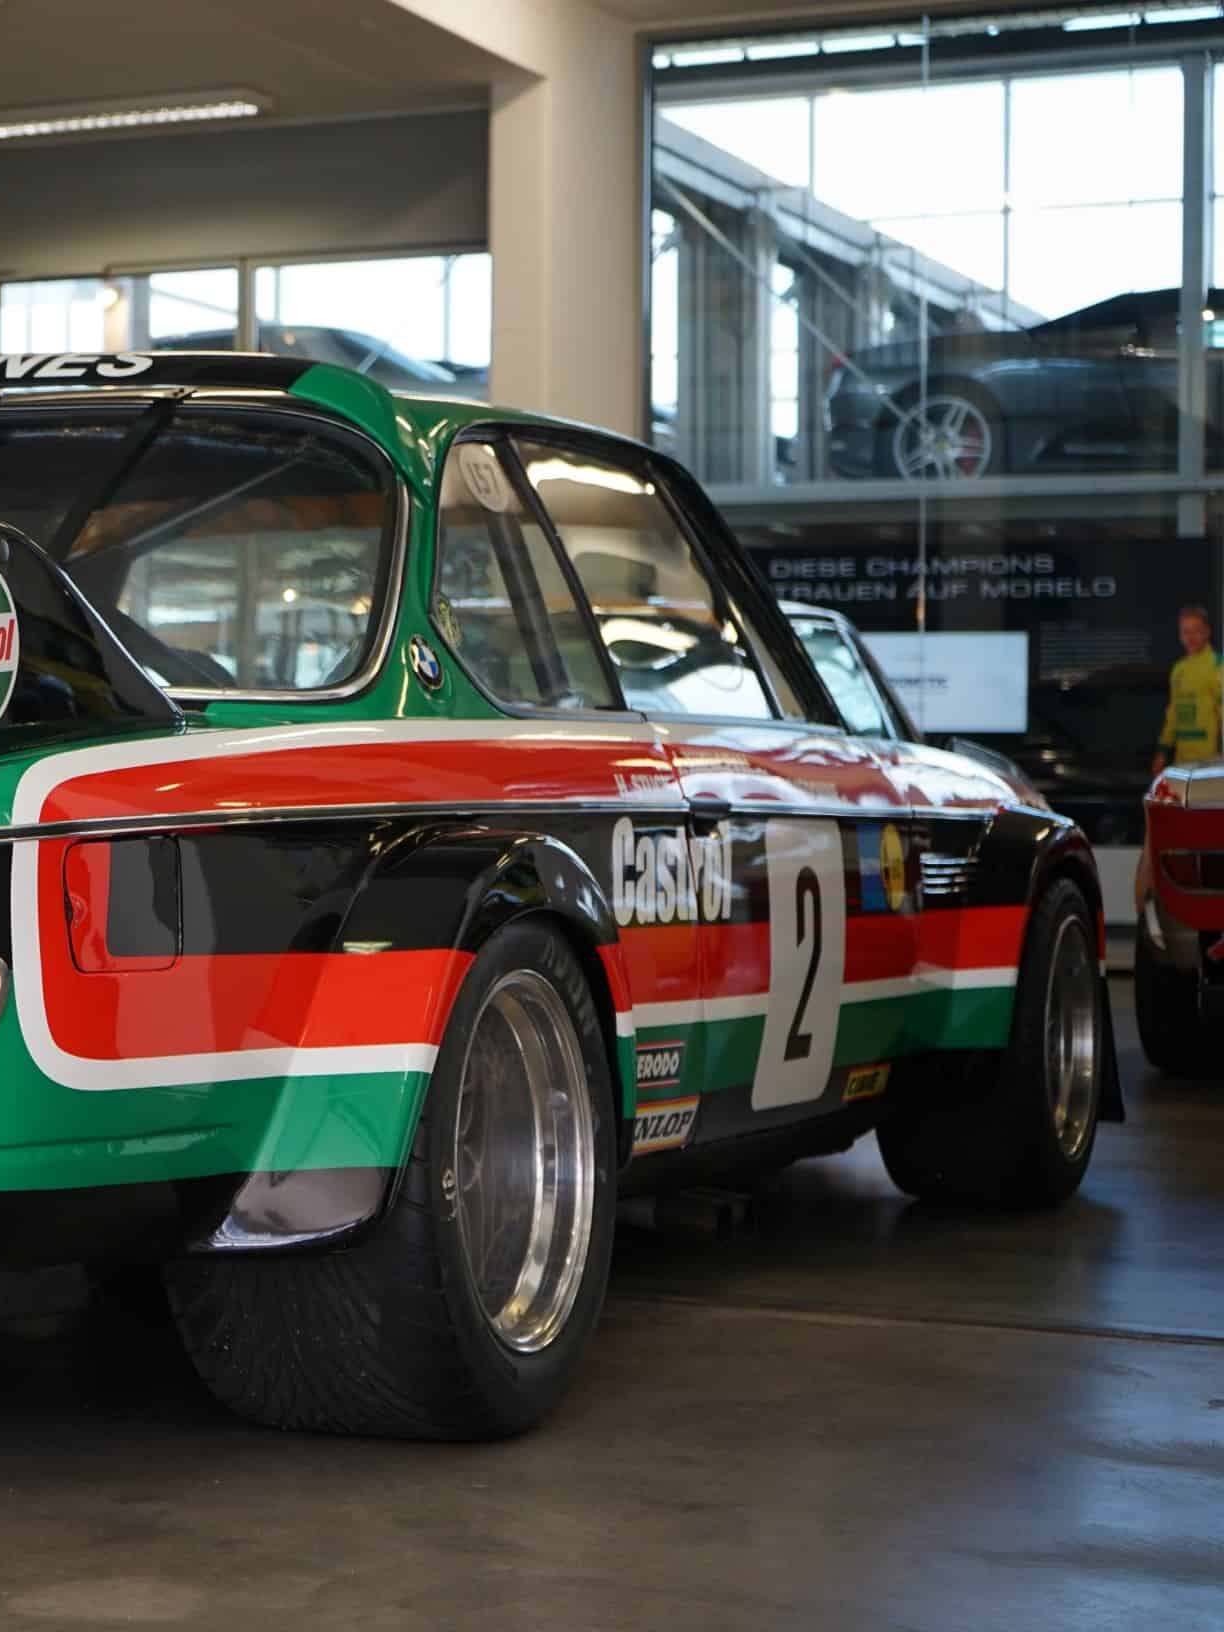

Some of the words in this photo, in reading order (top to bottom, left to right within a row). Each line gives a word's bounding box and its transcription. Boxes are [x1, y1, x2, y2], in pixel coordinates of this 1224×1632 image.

[865, 552, 1055, 577] CHAMPIONS
[907, 578, 969, 599] AUF
[980, 576, 1118, 599] MORELO
[612, 815, 733, 926] Castrol
[783, 866, 823, 1062] 2
[637, 1052, 680, 1080] ERODO
[633, 1108, 696, 1140] NLOP
